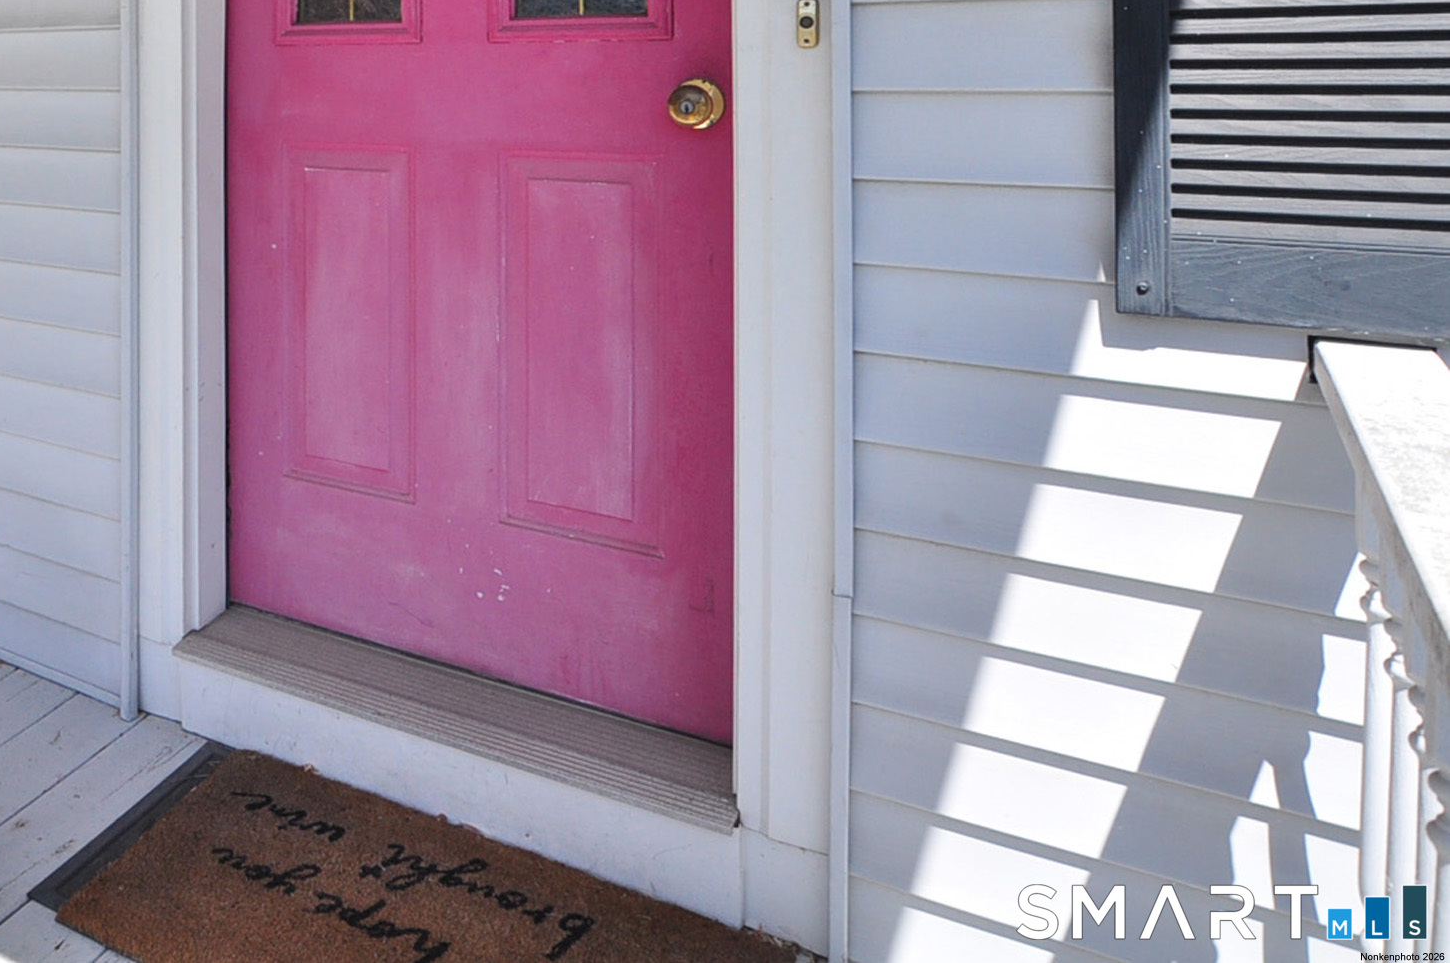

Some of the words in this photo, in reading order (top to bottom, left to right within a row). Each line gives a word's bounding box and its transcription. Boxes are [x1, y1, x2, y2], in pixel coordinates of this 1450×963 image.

[230, 790, 347, 843] wine
[210, 846, 322, 896] you
[359, 843, 596, 962] brought
[307, 890, 450, 963] hope
